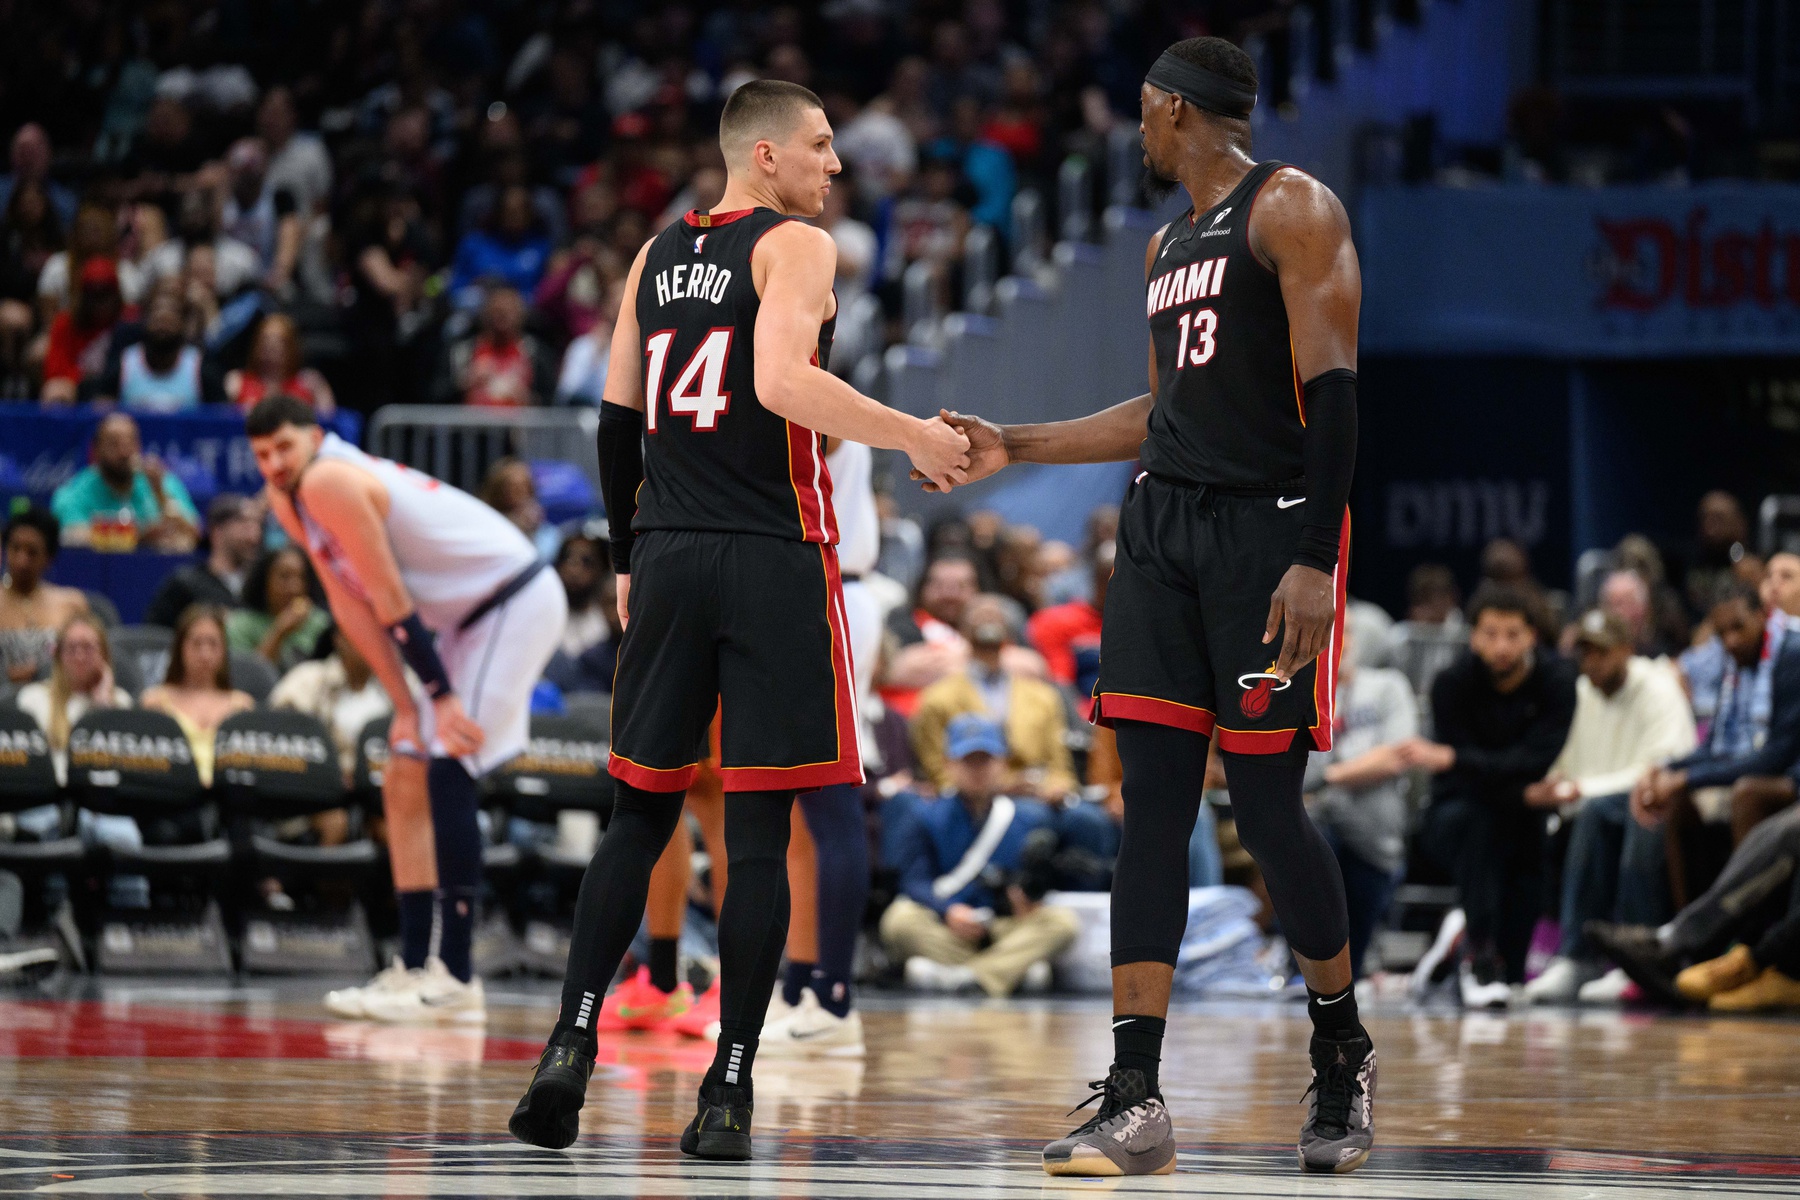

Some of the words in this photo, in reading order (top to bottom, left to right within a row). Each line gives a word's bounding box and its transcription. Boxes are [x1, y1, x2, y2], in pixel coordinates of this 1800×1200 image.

[1200, 227, 1231, 239] Robinhood
[655, 263, 732, 307] HERRO
[1146, 256, 1229, 320] MIAMI
[1176, 306, 1220, 371] 13
[645, 326, 735, 434] 14
[70, 727, 192, 765] CAESARS
